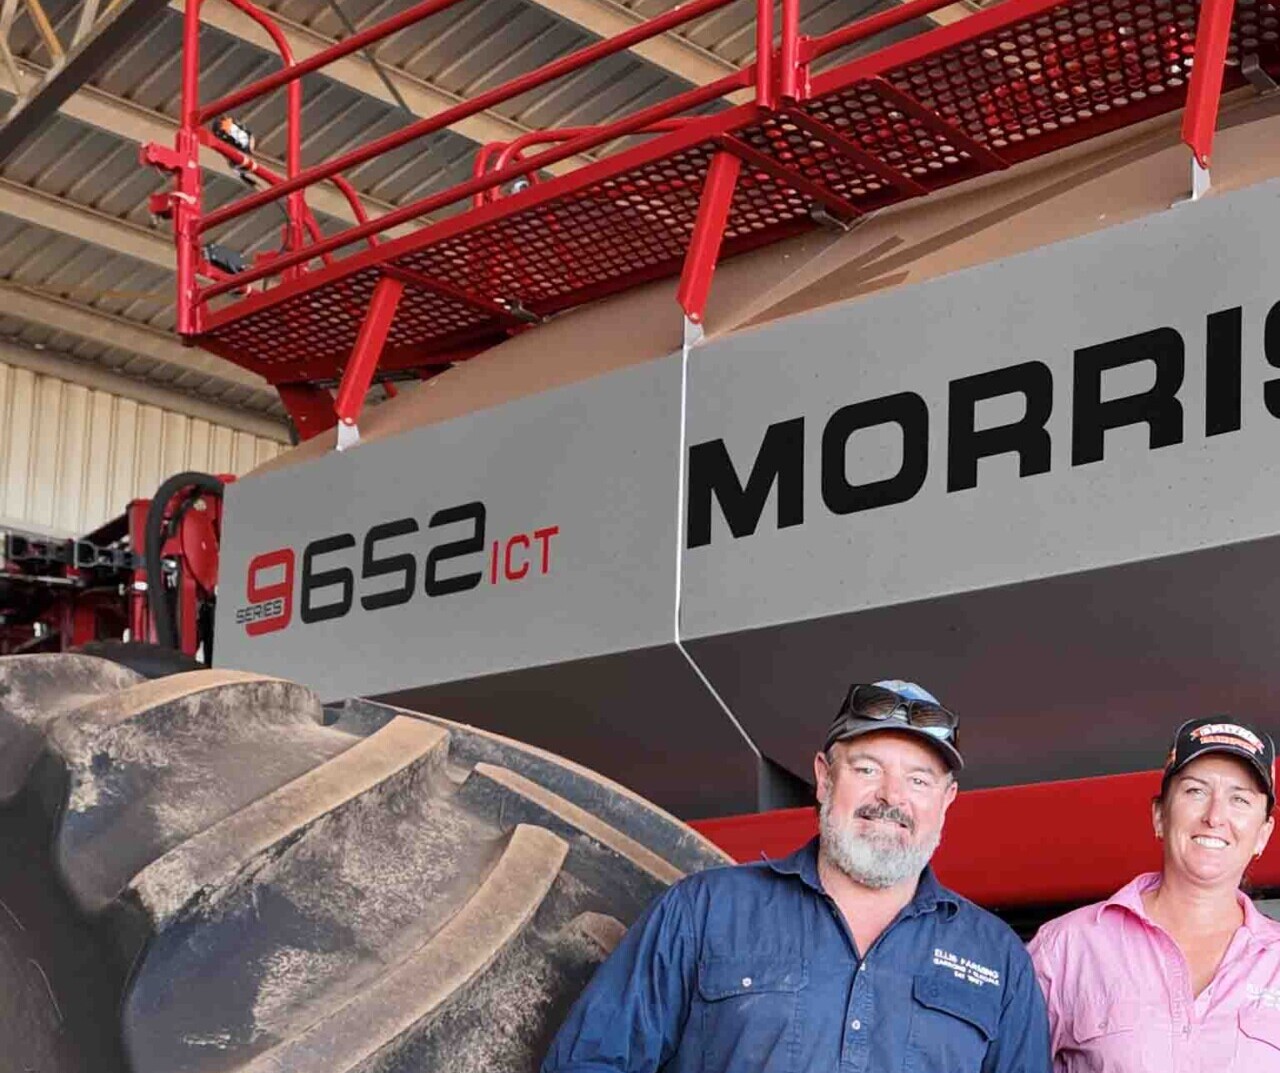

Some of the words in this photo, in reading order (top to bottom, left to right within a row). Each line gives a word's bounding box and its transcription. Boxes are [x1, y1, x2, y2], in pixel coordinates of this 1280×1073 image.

[245, 501, 487, 636] 9652
[489, 525, 559, 585] ICT
[236, 599, 283, 624] SERIES
